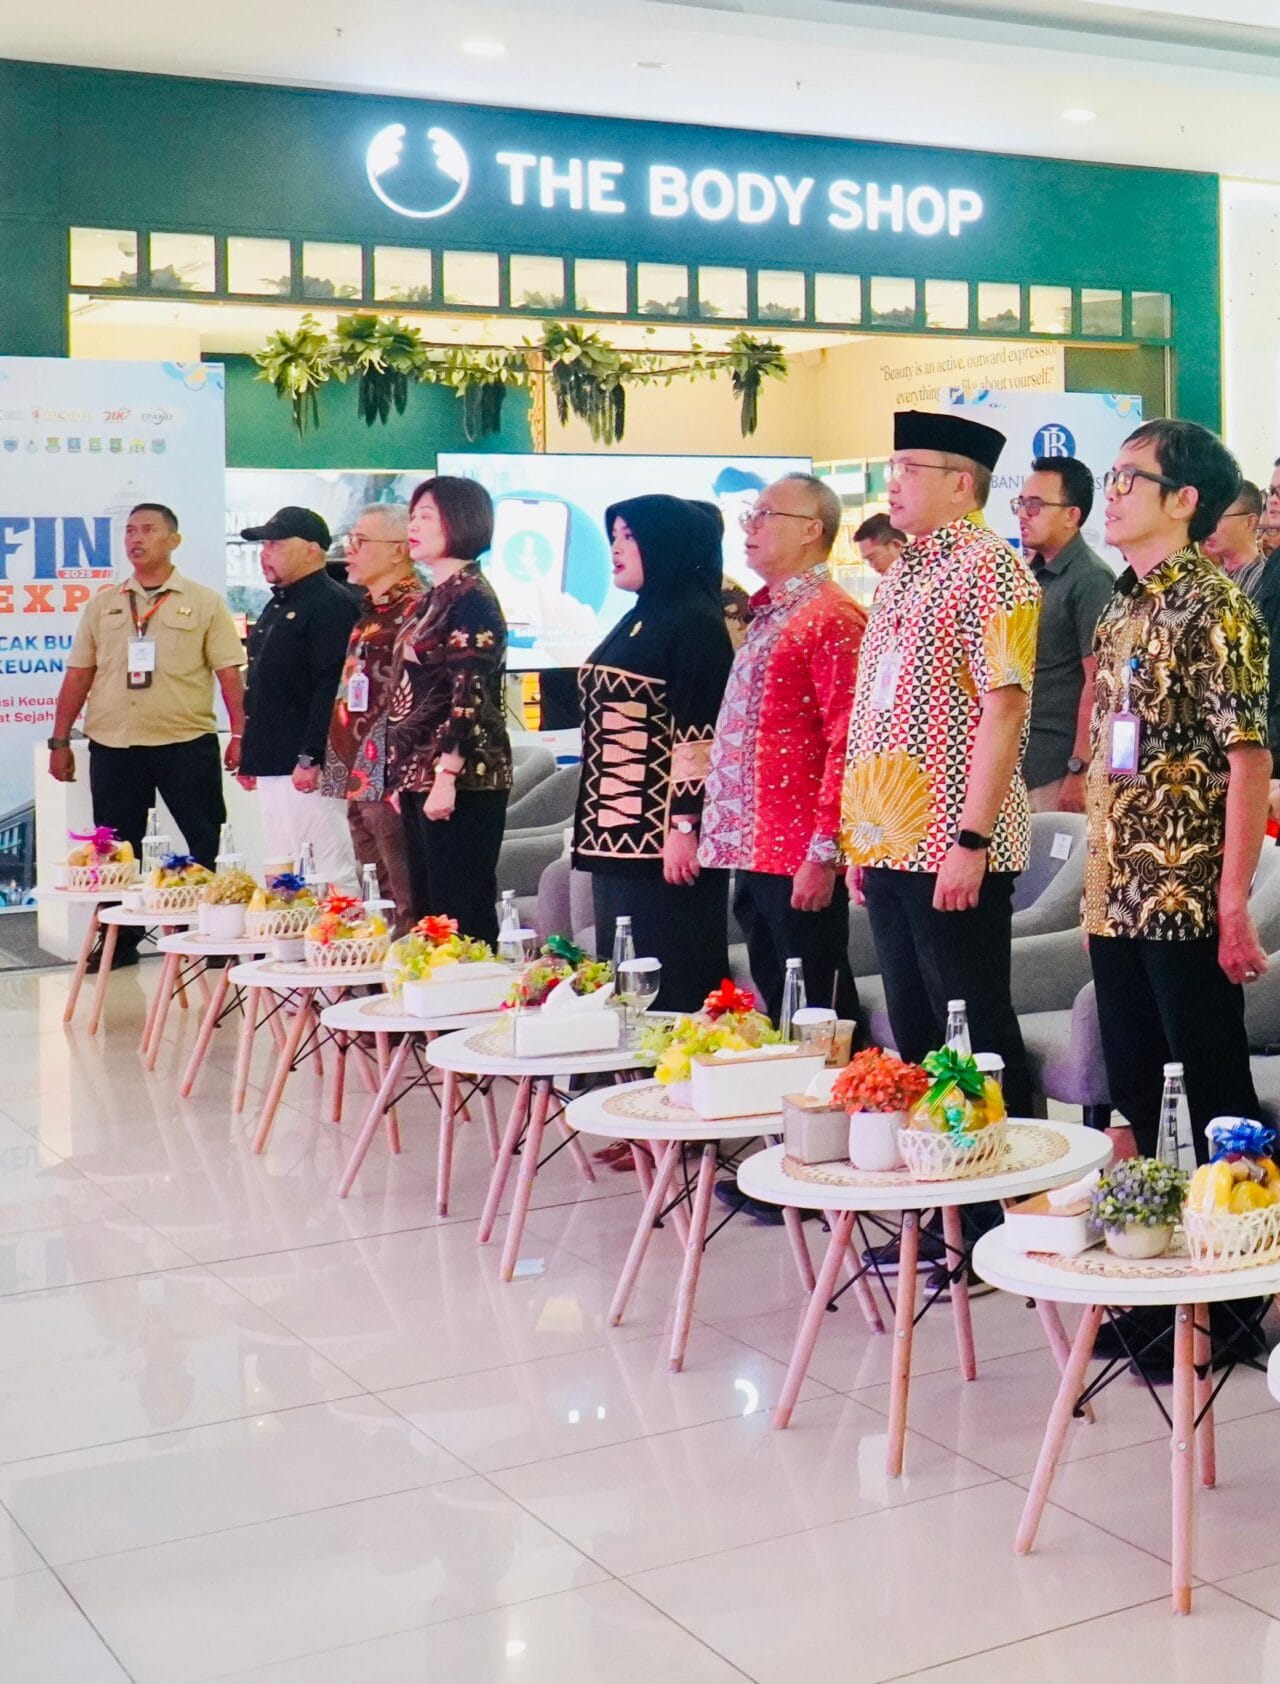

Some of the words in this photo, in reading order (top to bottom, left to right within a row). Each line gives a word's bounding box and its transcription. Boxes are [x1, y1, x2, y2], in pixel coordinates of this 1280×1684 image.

[496, 152, 625, 213] THE
[649, 165, 815, 226] BODY
[828, 179, 983, 237] SHOP
[915, 361, 923, 375] is
[924, 361, 935, 375] an
[967, 346, 1006, 369] outward
[1008, 344, 1057, 366] expressio
[991, 475, 1025, 489] BAN
[64, 570, 93, 578] 2025
[0, 584, 115, 613] EXP
[0, 659, 63, 674] EUAN
